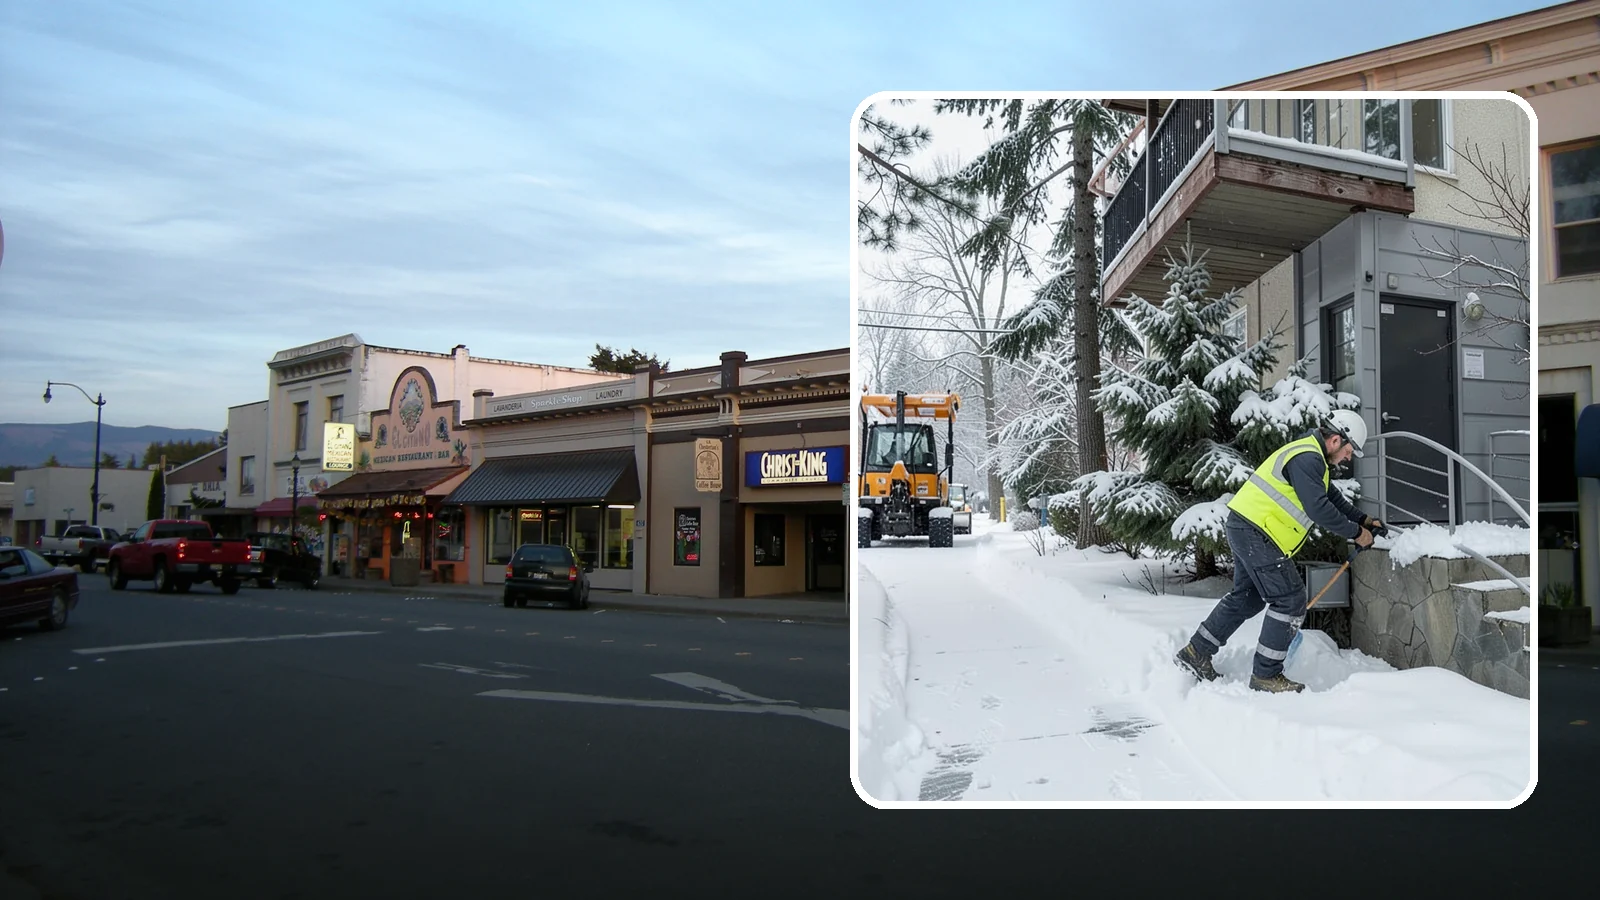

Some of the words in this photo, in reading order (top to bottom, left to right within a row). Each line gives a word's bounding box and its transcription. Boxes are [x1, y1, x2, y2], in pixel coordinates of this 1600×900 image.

[493, 402, 522, 412] LAVANDERIA
[531, 397, 561, 408] Sparkle
[562, 394, 582, 404] Shop
[595, 389, 624, 400] LAUNDRY
[392, 425, 402, 449] EL
[373, 454, 396, 464] MEXICAN
[397, 451, 433, 462] RESTAURANT
[437, 450, 450, 459] BAR
[761, 451, 797, 478] CHRIST
[799, 450, 827, 477] KING
[697, 481, 709, 489] Coffee
